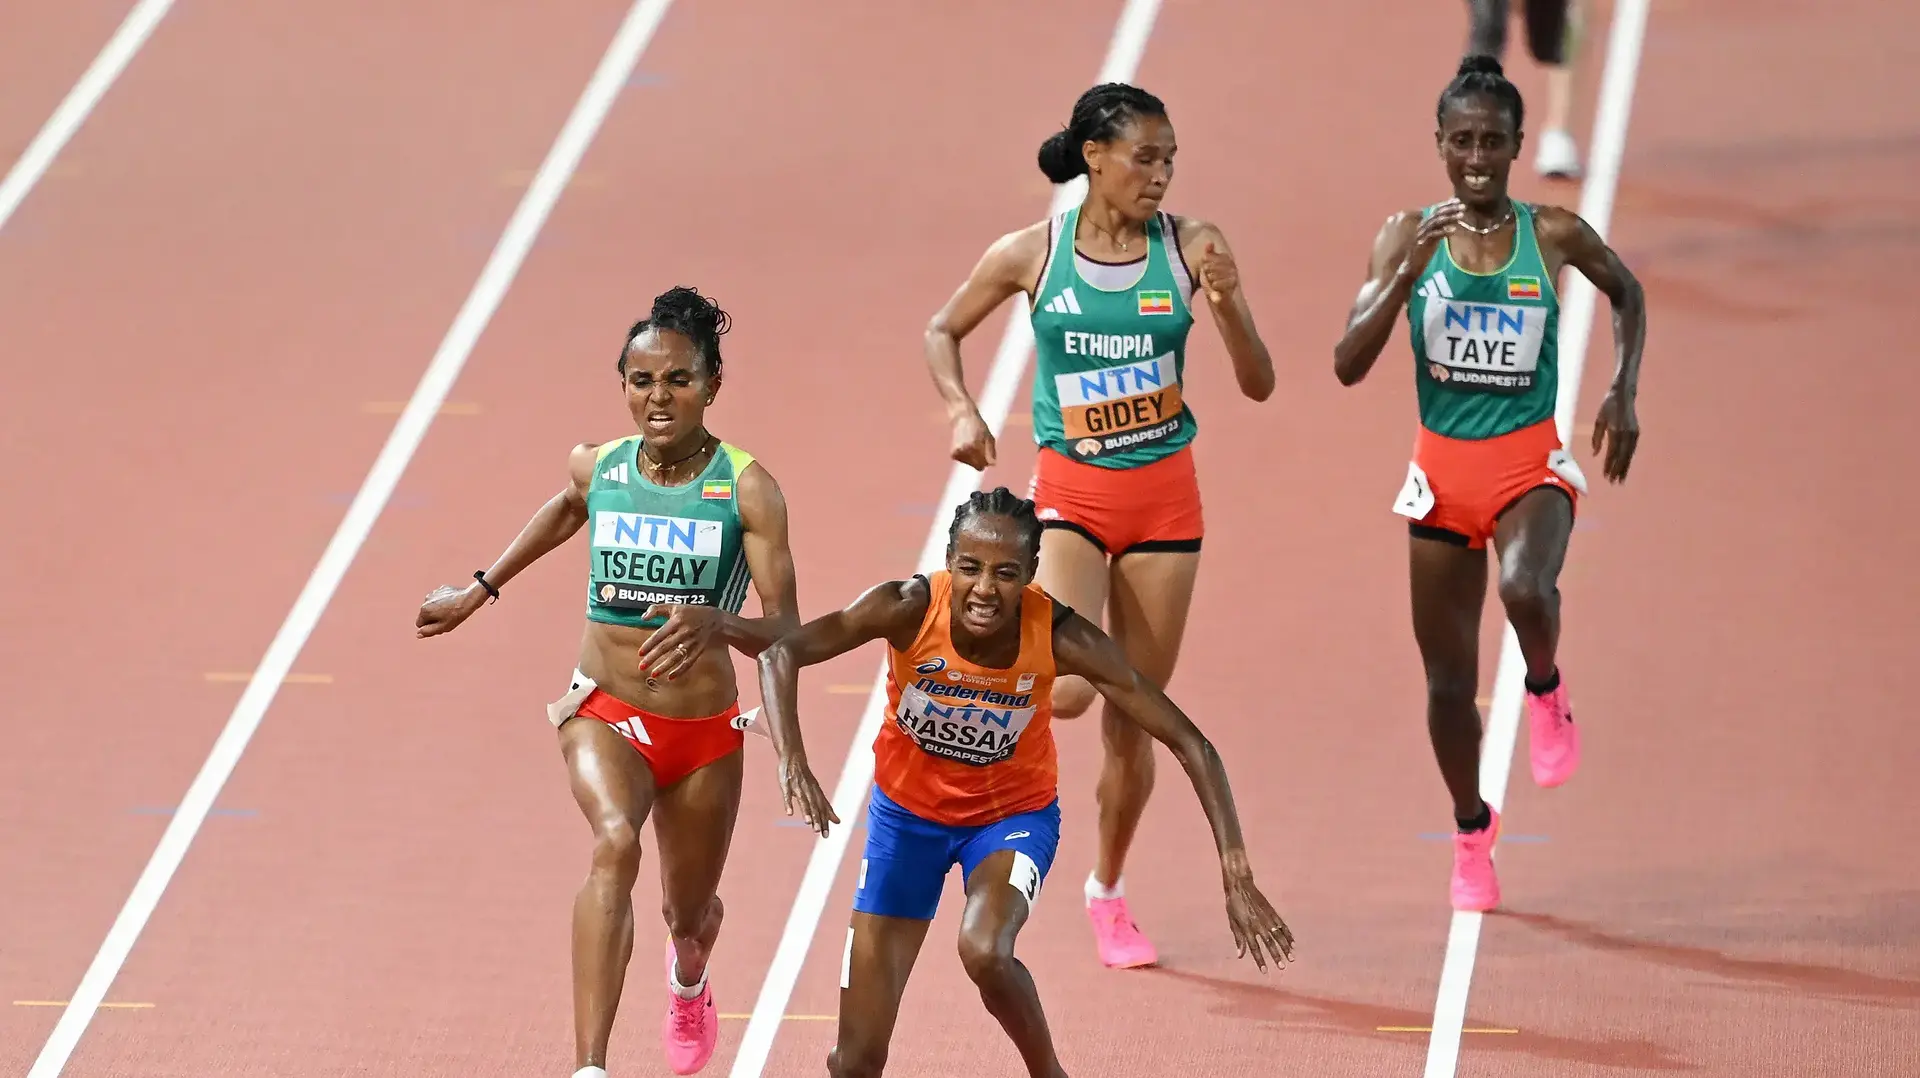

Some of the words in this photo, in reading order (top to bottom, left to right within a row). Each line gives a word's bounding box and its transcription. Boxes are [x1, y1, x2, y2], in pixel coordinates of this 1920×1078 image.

[1445, 304, 1524, 335] NTN
[1064, 331, 1154, 359] ETHIOPIA
[1447, 336, 1516, 366] TAYE
[1079, 361, 1161, 401] NTN
[1085, 393, 1164, 433] GIDEY
[1104, 427, 1167, 450] BUDAPEST
[614, 515, 696, 552] NTN
[600, 550, 708, 585] TSEGAY
[618, 588, 690, 605] BUDAPEST
[903, 708, 1018, 751] HASSAN
[923, 700, 1013, 730] NTN
[924, 742, 994, 765] BUDAPEST
